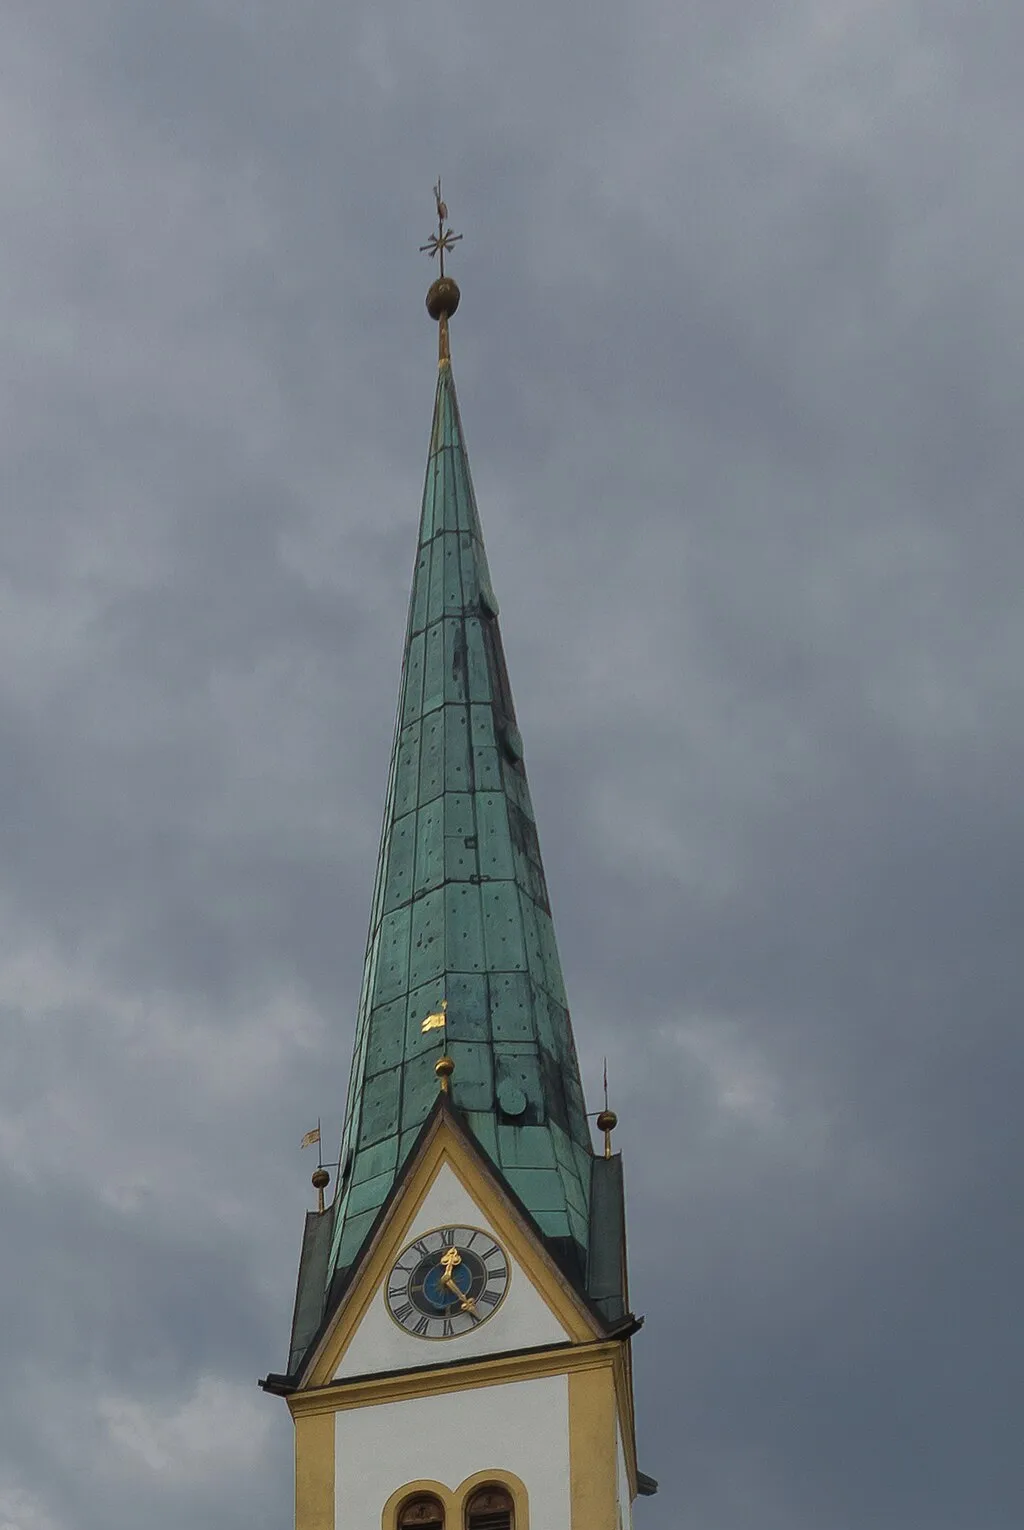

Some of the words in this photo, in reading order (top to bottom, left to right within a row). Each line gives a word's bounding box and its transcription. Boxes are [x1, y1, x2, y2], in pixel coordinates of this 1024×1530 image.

[440, 1229, 455, 1247] XII
[466, 1231, 479, 1248] I
[412, 1240, 429, 1259] XI
[481, 1243, 500, 1260] II
[394, 1262, 412, 1275] X
[488, 1266, 507, 1280] III
[389, 1286, 408, 1299] IX
[442, 1319, 455, 1336] VI
